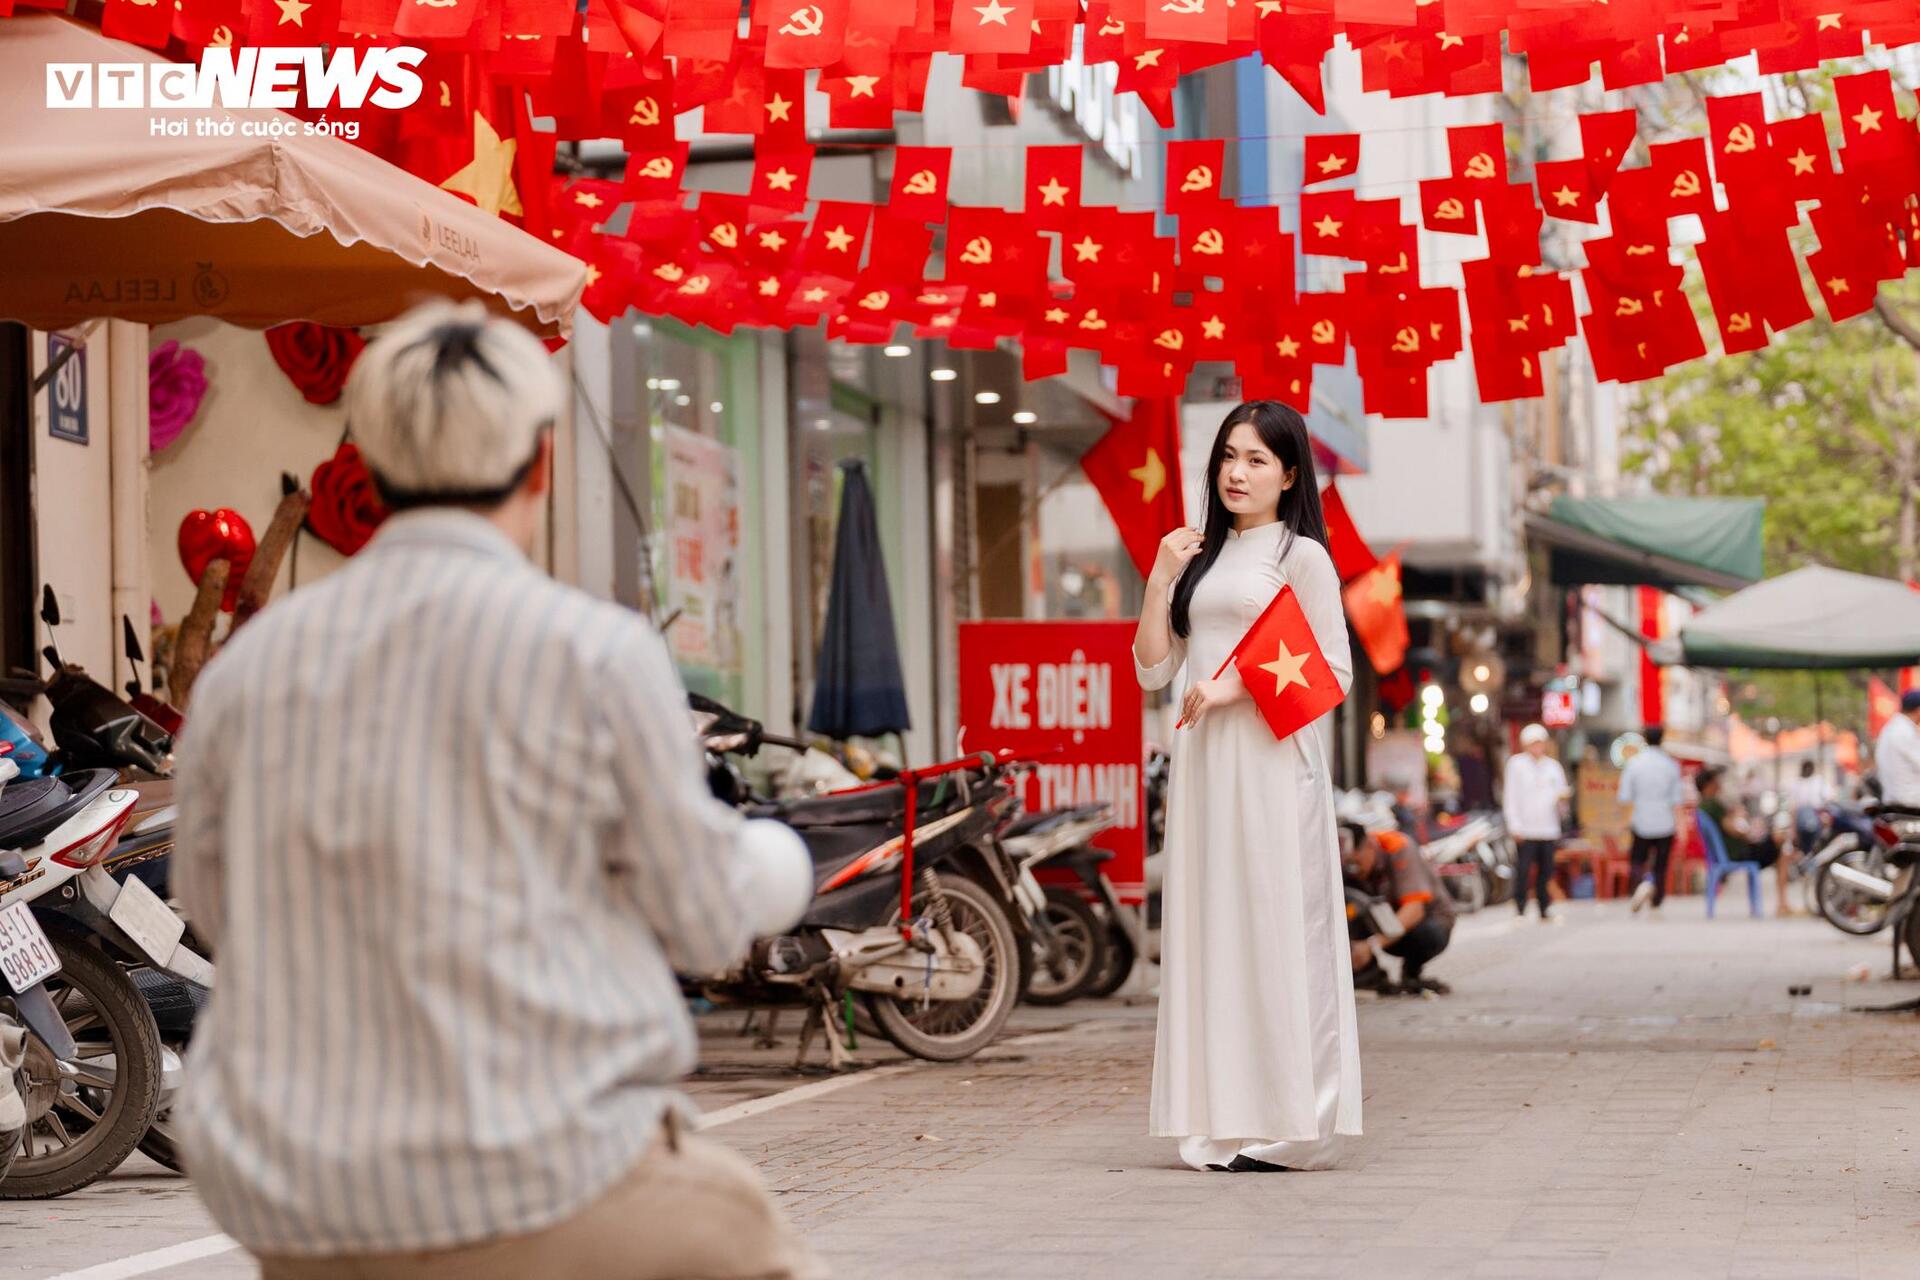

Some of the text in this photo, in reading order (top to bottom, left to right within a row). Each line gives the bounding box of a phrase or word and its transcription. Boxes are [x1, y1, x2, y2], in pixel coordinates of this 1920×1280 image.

[438, 223, 481, 264] LEELAA
[990, 649, 1112, 744] XE ĐIỆN
